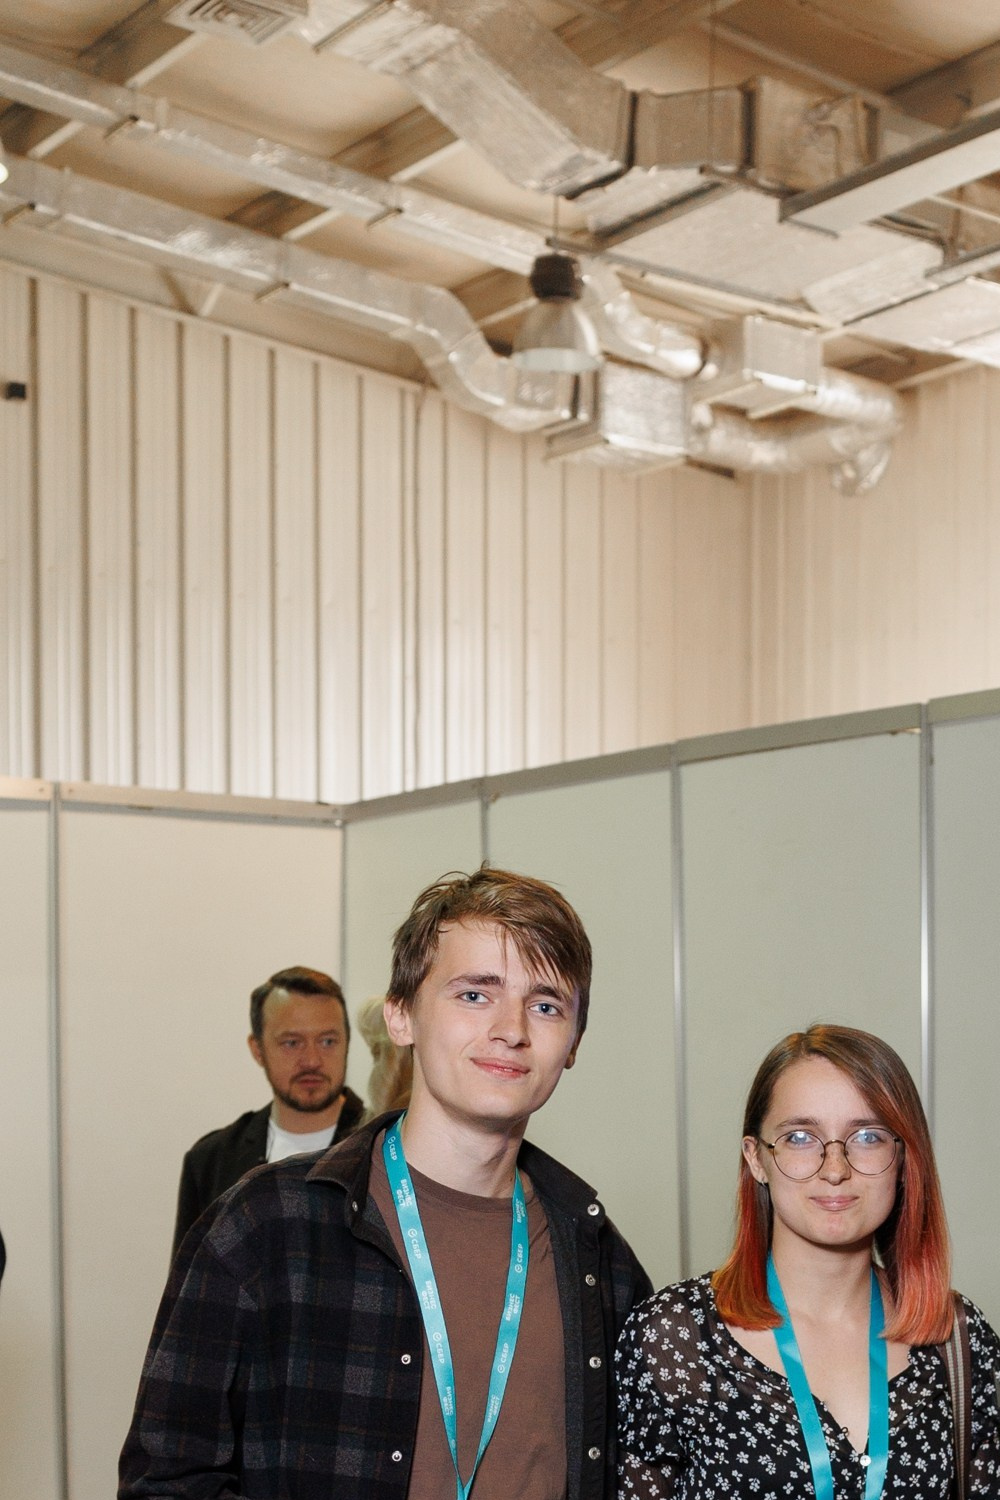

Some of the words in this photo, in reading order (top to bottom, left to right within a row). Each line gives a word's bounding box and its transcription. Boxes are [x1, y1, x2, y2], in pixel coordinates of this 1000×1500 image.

[396, 1189, 405, 1207] ФЕСТ
[401, 1179, 412, 1209] БИЗНЕС
[411, 1239, 422, 1259] СБЕР
[421, 1291, 430, 1310] ФЕСТ
[425, 1280, 436, 1310] БИЗНЕС
[513, 1295, 521, 1314] ФЕСТ
[506, 1293, 516, 1322] БИЗНЕС
[435, 1343, 445, 1364] СБЕР
[501, 1342, 509, 1363] СБЕР
